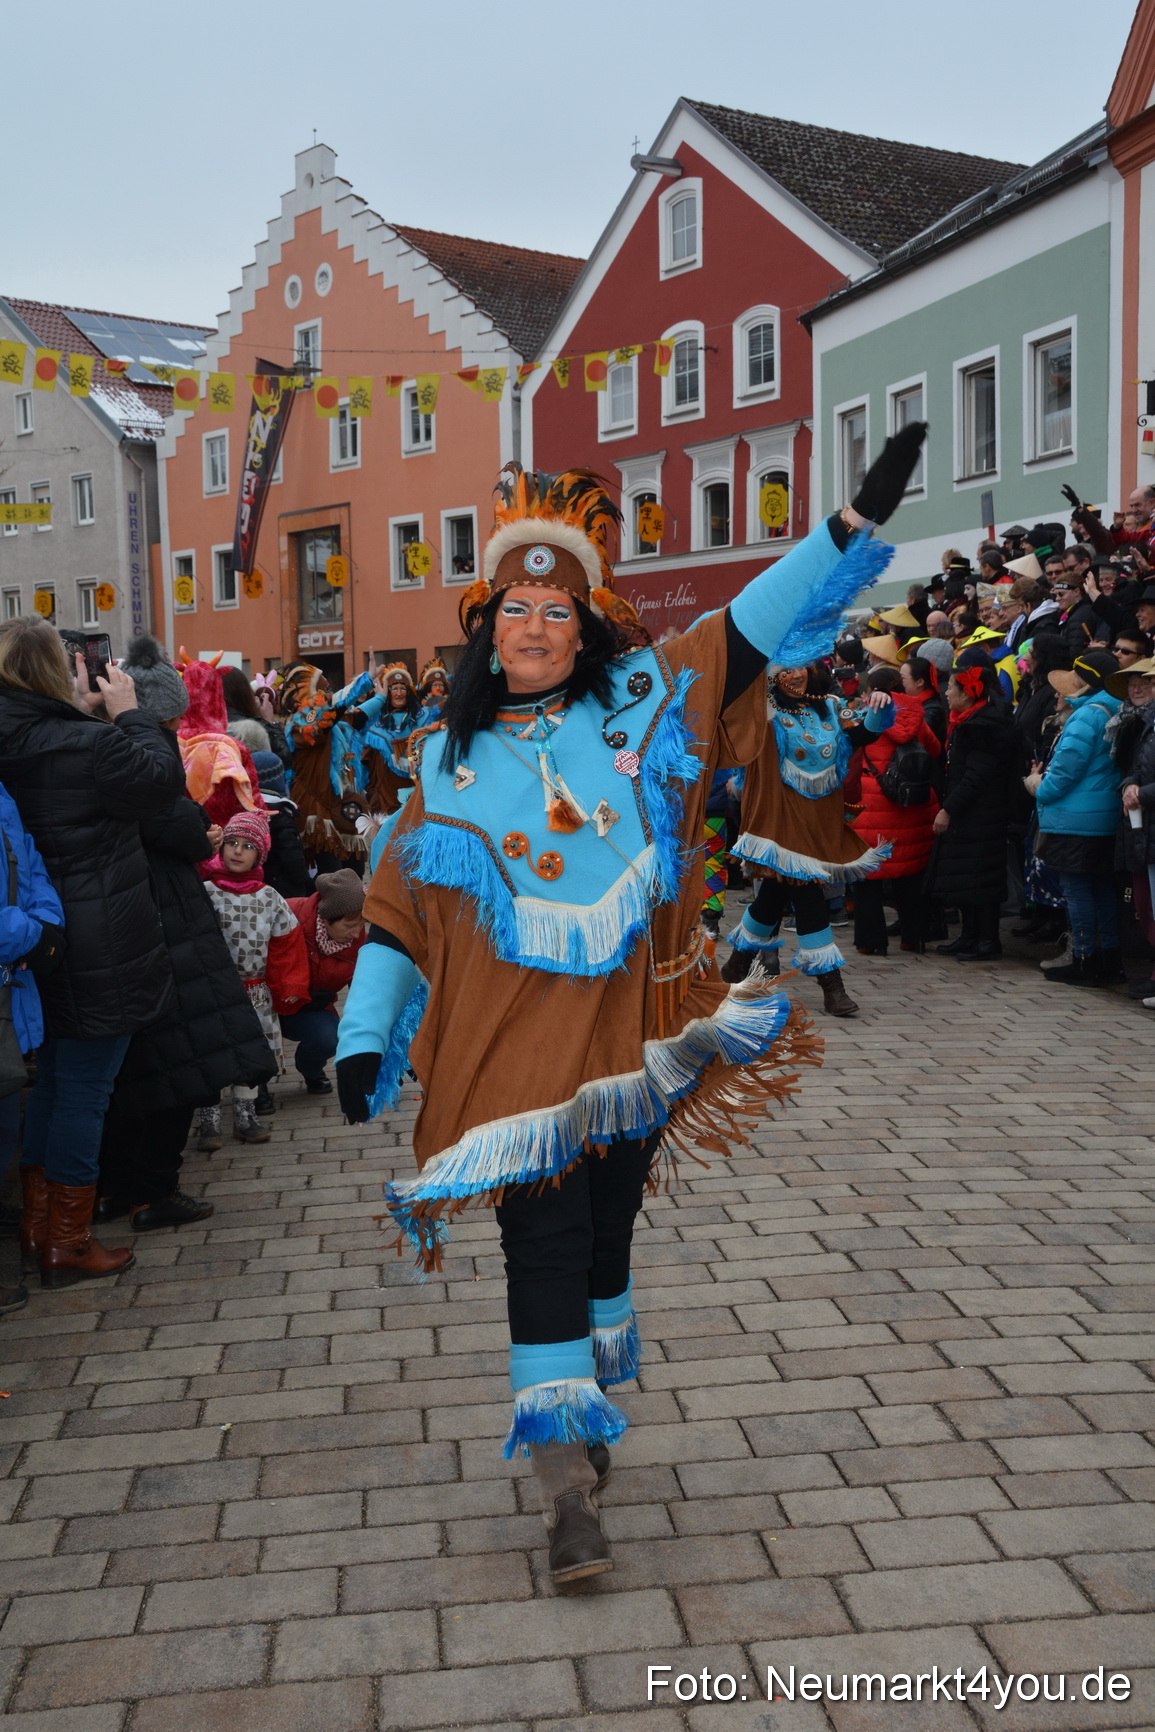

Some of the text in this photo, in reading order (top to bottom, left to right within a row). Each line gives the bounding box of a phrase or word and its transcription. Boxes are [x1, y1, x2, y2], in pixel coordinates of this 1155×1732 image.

[128, 493, 142, 636] UHREN SCHMUC
[636, 595, 662, 617] Genuss
[664, 582, 697, 608] Erlebnis
[298, 631, 344, 648] GÖTZ
